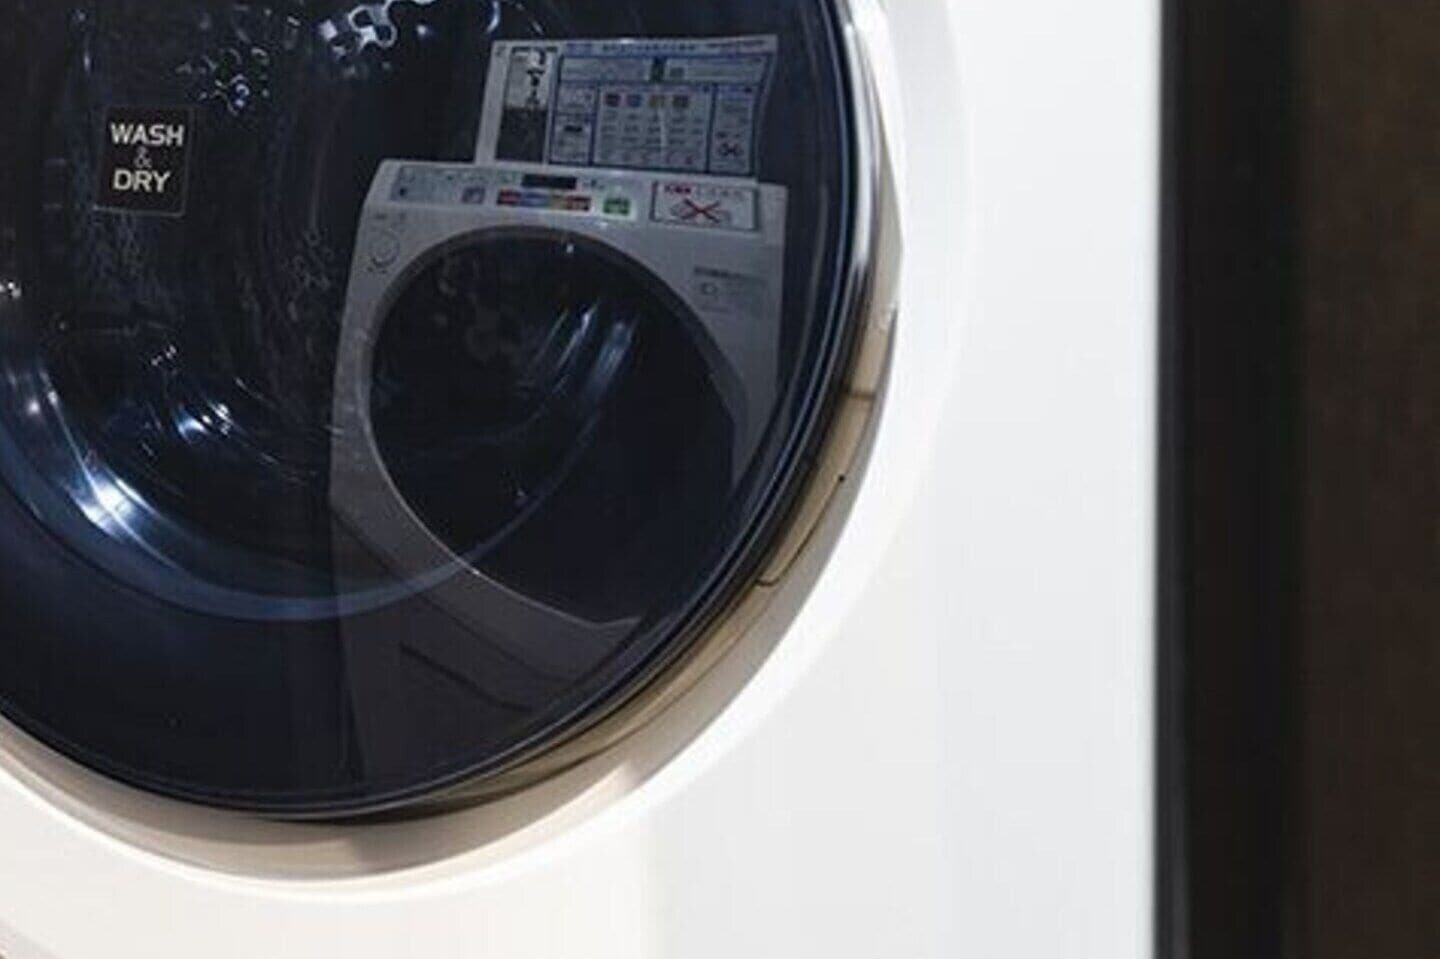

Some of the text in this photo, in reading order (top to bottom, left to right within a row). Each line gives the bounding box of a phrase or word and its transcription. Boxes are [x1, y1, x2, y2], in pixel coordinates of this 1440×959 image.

[110, 123, 184, 147] WASH
[133, 146, 153, 169] &
[112, 168, 171, 193] DRY
